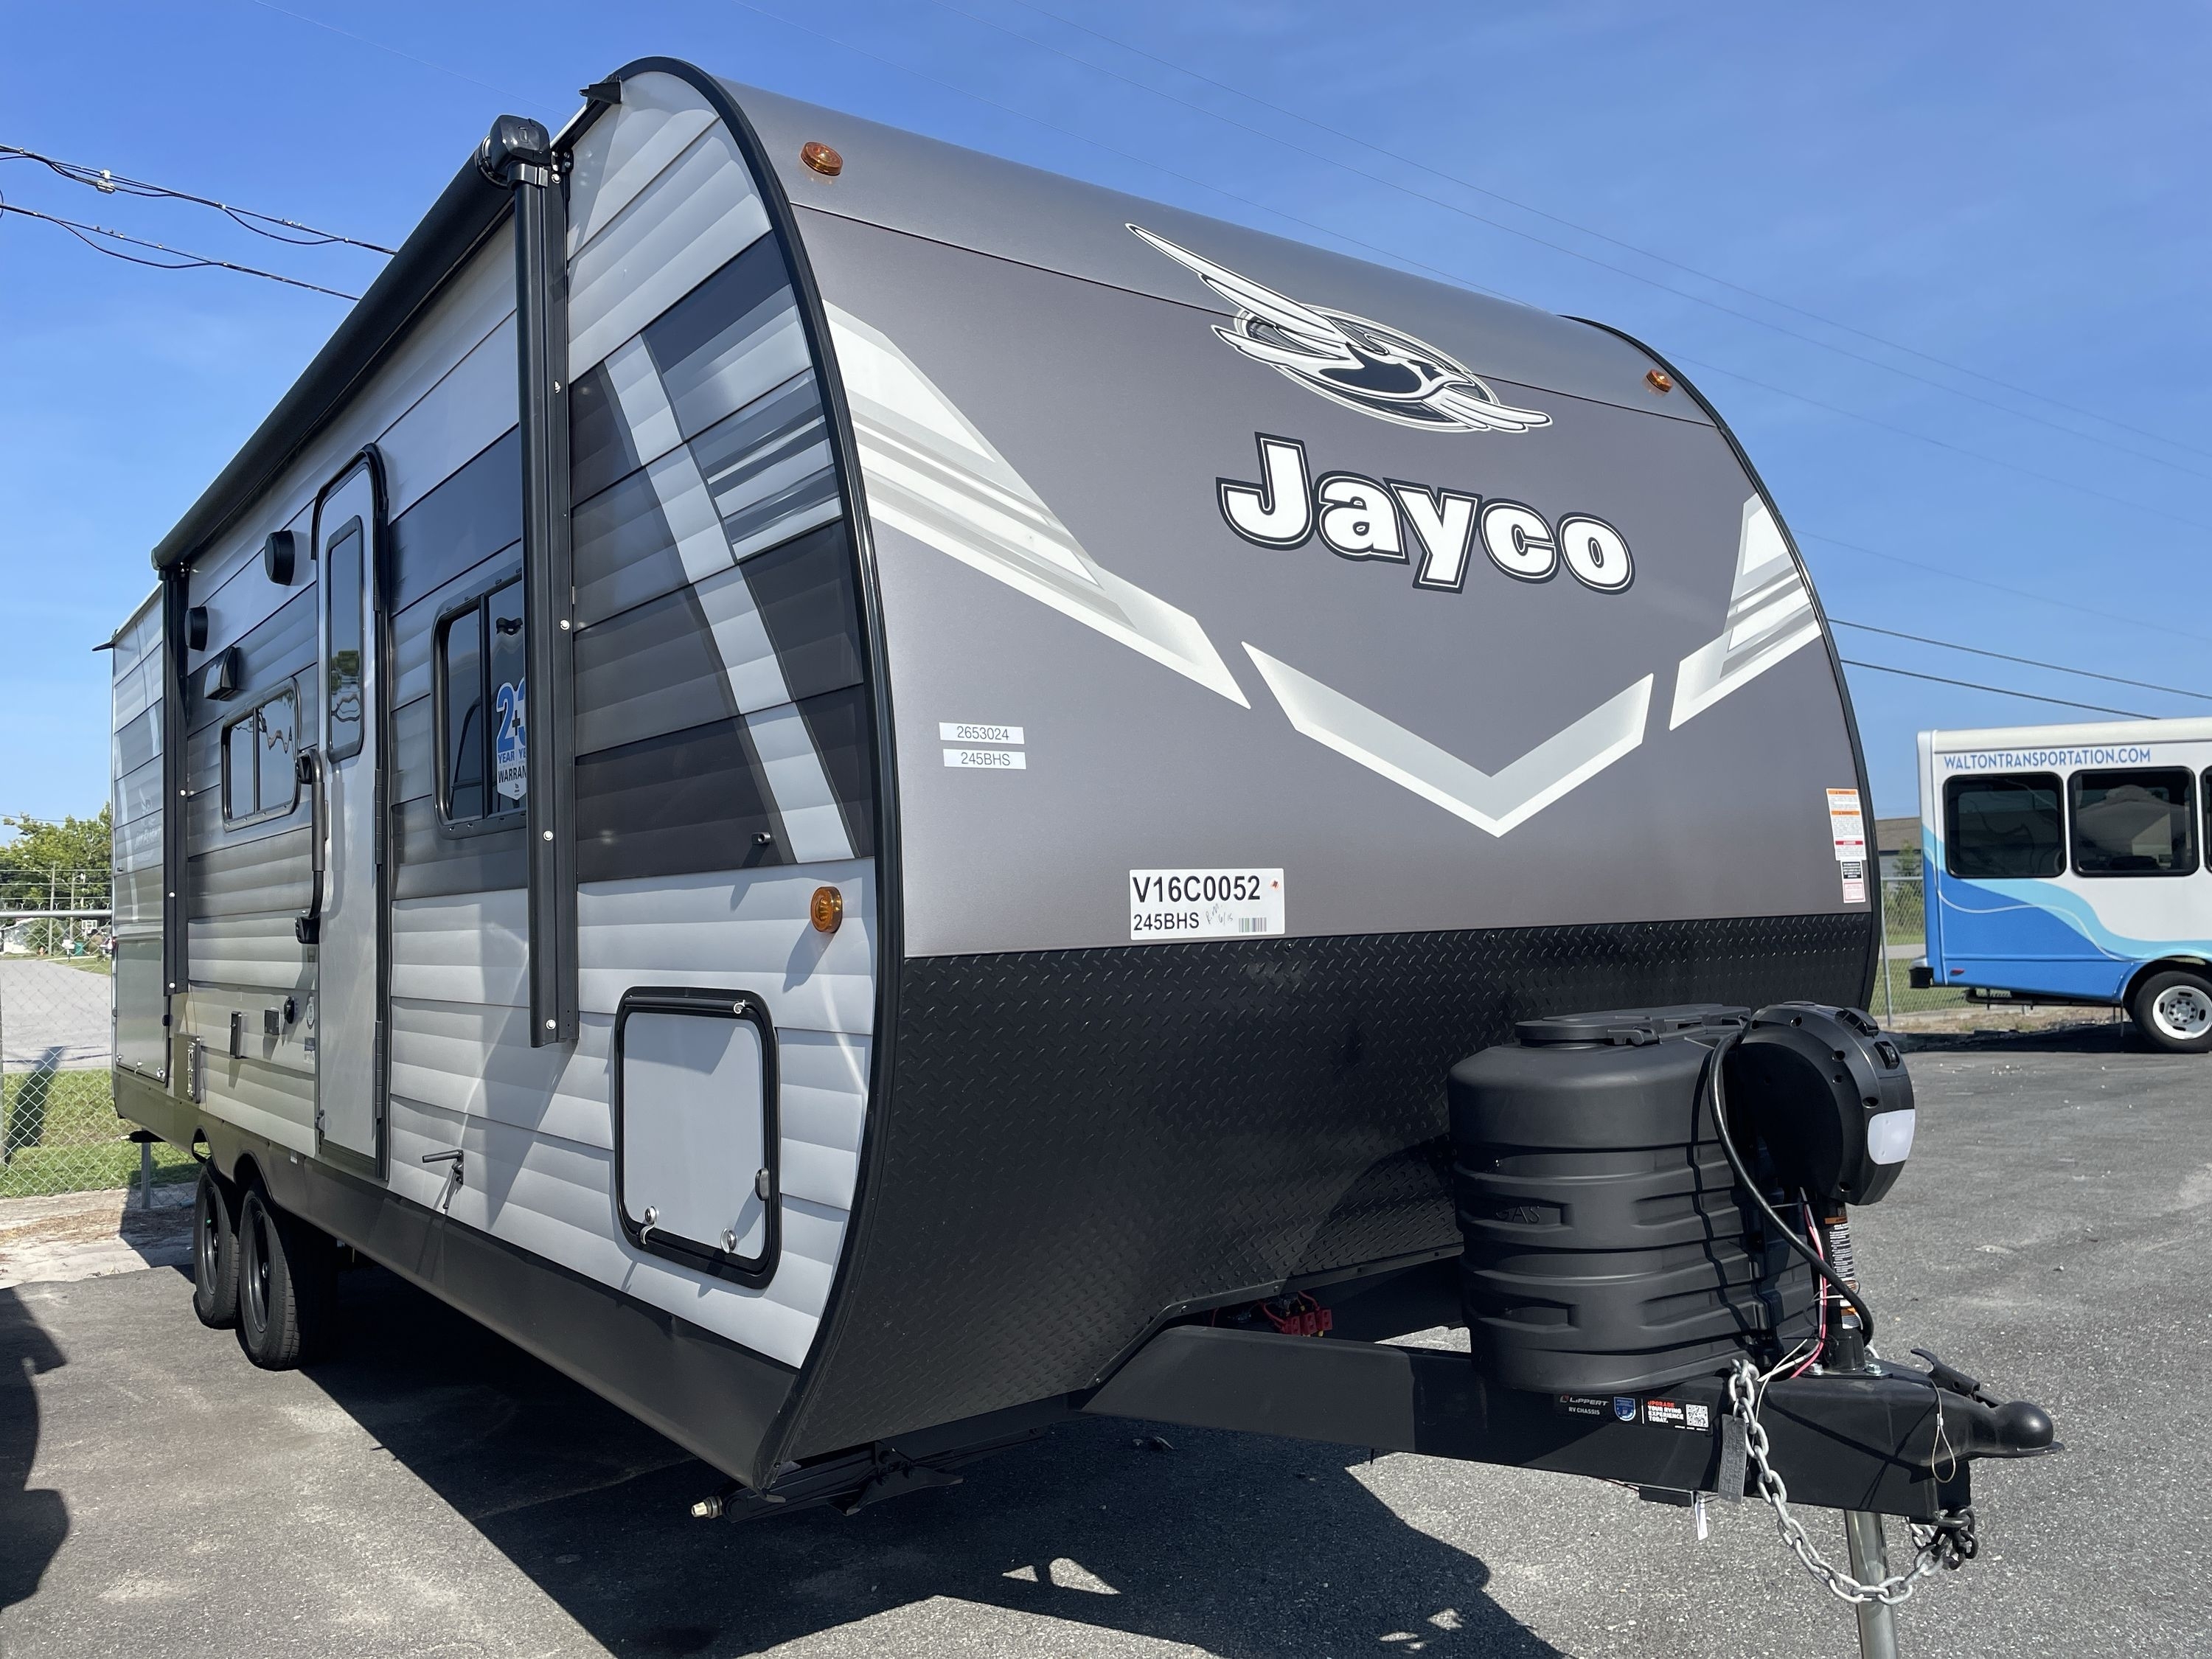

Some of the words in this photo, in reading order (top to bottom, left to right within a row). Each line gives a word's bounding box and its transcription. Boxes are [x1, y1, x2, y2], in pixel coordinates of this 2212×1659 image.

[1217, 433, 1635, 594] Jayco
[957, 726, 1009, 740] 2653024
[498, 751, 515, 764] YEAR
[961, 752, 1011, 766] 245BHS
[1944, 748, 2151, 770] WALTONTRANSPORTATION.COM
[498, 765, 526, 784] WARRAN
[1133, 875, 1260, 902] V16C0052
[1133, 912, 1200, 931] 245BHS
[1648, 1411, 1684, 1419] EXPERIENCE
